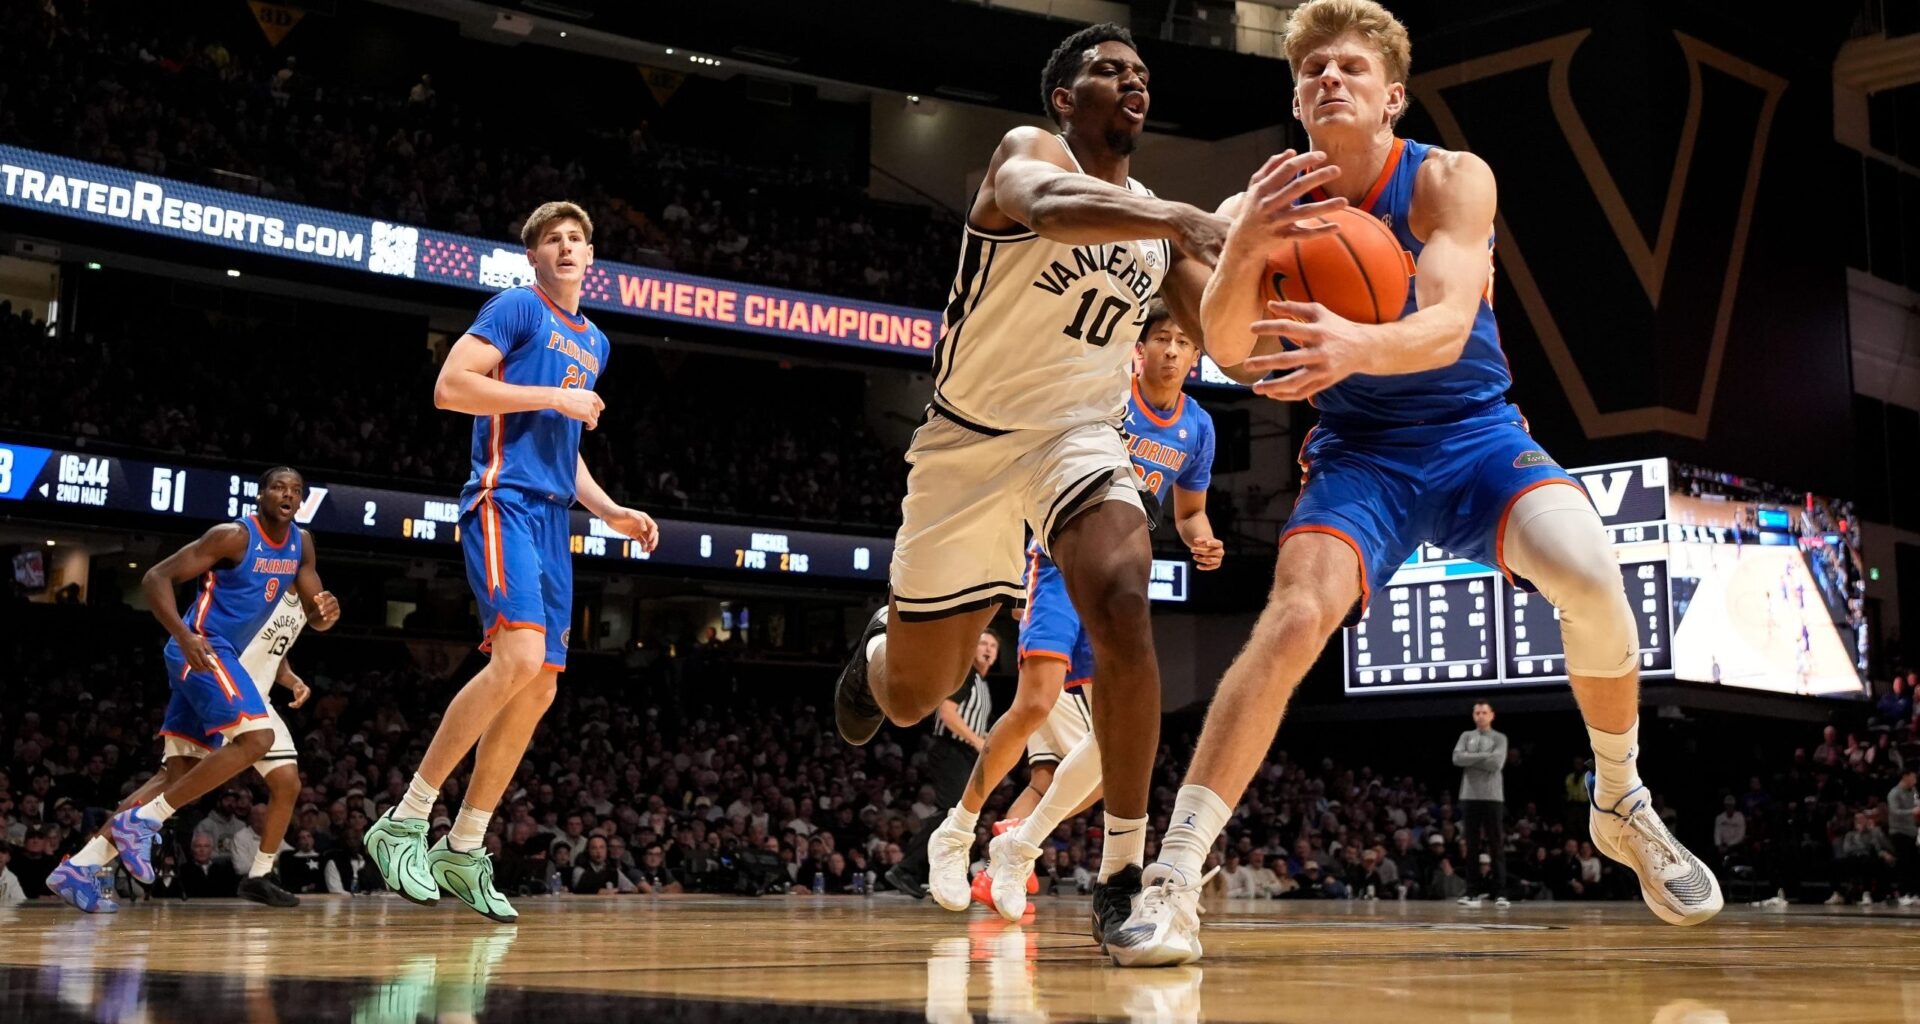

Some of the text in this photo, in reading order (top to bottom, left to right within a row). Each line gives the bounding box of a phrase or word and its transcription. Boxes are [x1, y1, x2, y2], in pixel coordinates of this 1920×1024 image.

[0, 164, 363, 262] TRATEDRESORTS.COM
[618, 274, 933, 350] WHERE CHAMPIONS
[1063, 287, 1131, 347] 10
[546, 330, 600, 378] FLORIDA
[561, 364, 587, 389] 21
[1125, 432, 1187, 472] LORIDA
[59, 454, 110, 488] 16:44
[56, 484, 108, 506] 2ND HALF
[151, 467, 187, 513] 51
[1581, 470, 1633, 517] V
[363, 501, 377, 526] 2
[413, 518, 437, 540] PTS
[583, 535, 606, 556] PTS
[735, 549, 744, 568] 7
[744, 549, 767, 570] PTS
[780, 553, 790, 571] 2
[264, 577, 280, 602] 9
[268, 635, 289, 656] 13
